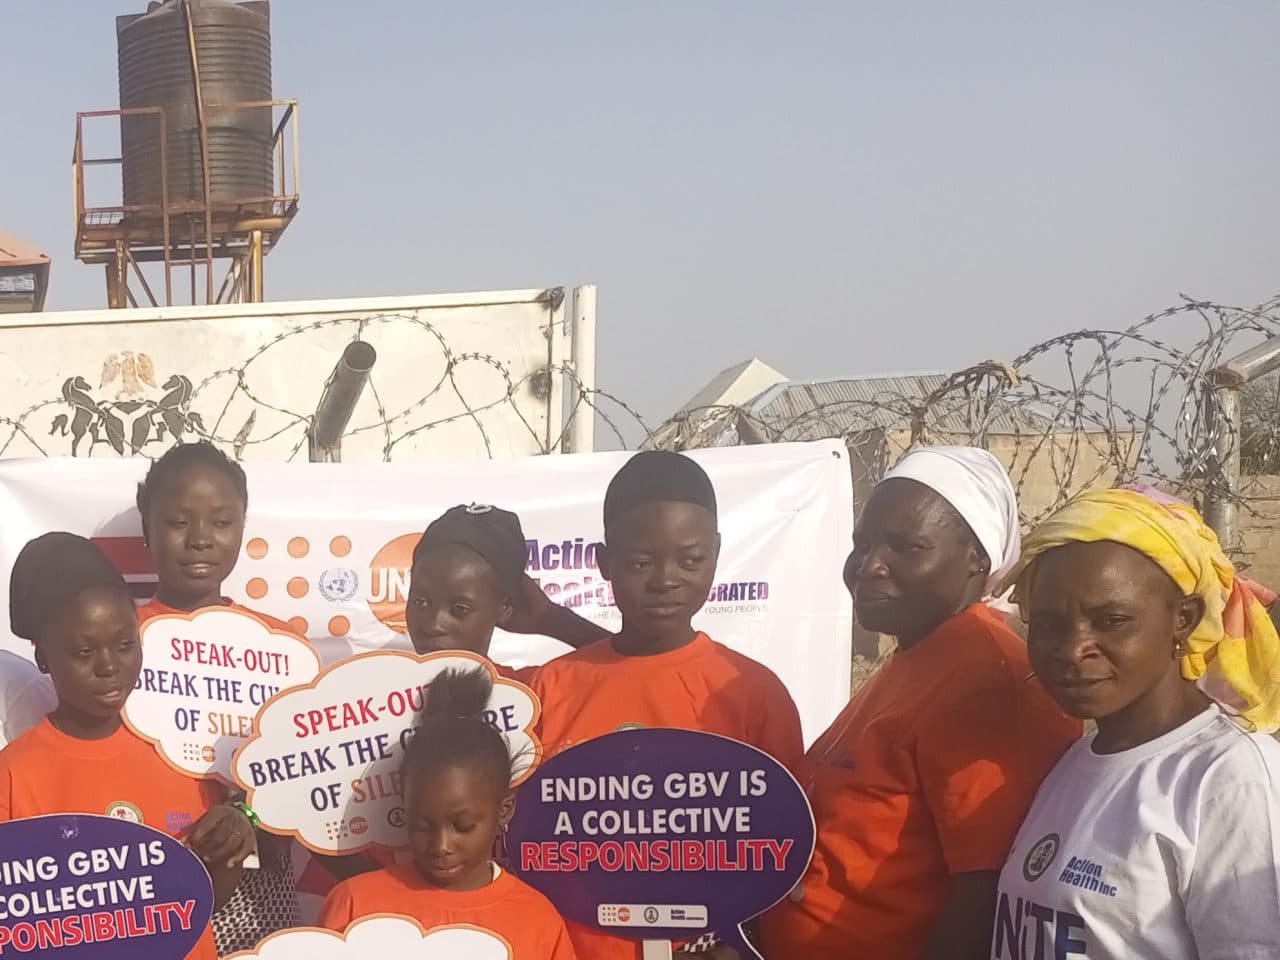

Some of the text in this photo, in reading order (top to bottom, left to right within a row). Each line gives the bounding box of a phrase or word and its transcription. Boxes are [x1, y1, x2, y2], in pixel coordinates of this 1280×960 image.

[525, 538, 599, 571] Actio
[170, 637, 289, 676] SPEAK-OUT!
[203, 676, 243, 704] THE
[174, 707, 255, 739] OF SILE
[292, 683, 432, 738] SPEAK-OU
[248, 733, 393, 787] BREAK THE
[310, 783, 342, 812] OF
[540, 769, 767, 802] ENDING GBV IS
[554, 806, 751, 835] A COLLECTIVE
[67, 845, 129, 876] GBV
[138, 840, 166, 867] IS
[520, 839, 794, 872] RESPONSIBILITY
[1066, 856, 1103, 878] Action
